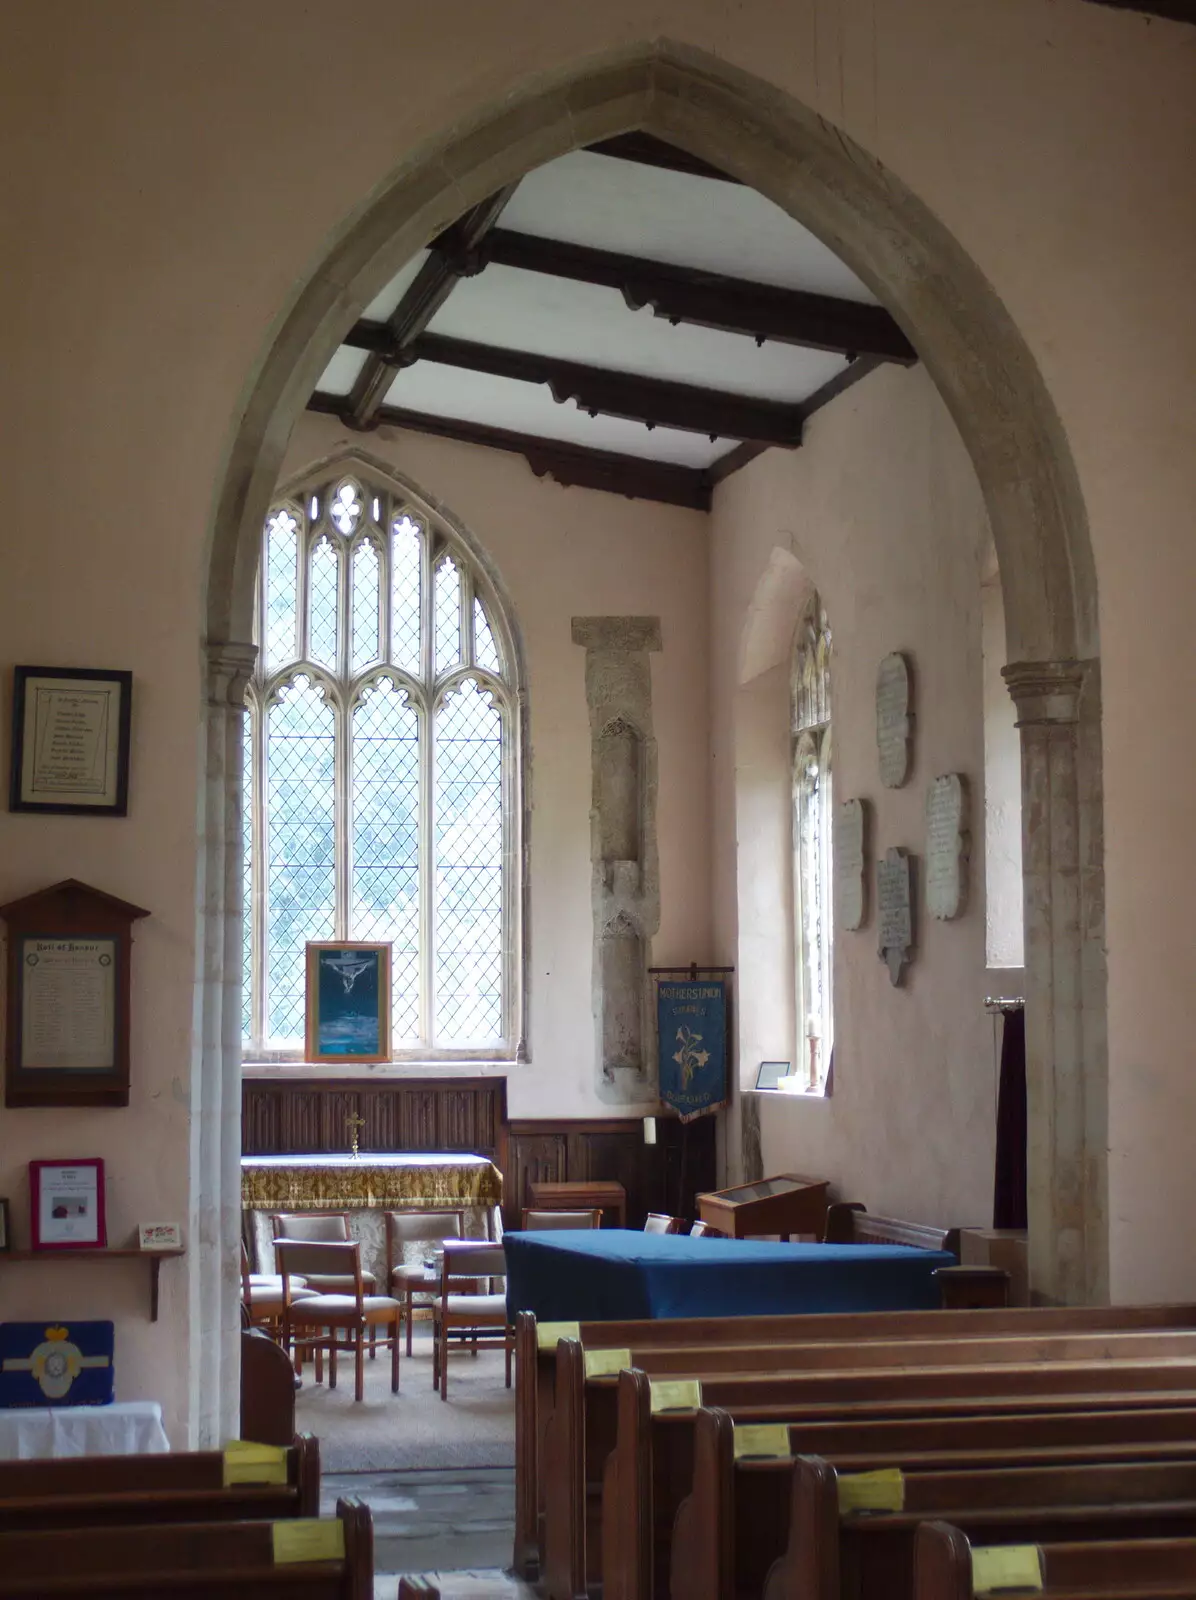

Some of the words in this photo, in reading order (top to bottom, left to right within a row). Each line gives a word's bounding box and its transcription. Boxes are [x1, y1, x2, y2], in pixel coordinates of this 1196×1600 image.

[37, 942, 55, 952] Roll
[57, 943, 66, 952] of
[67, 942, 98, 953] Honour
